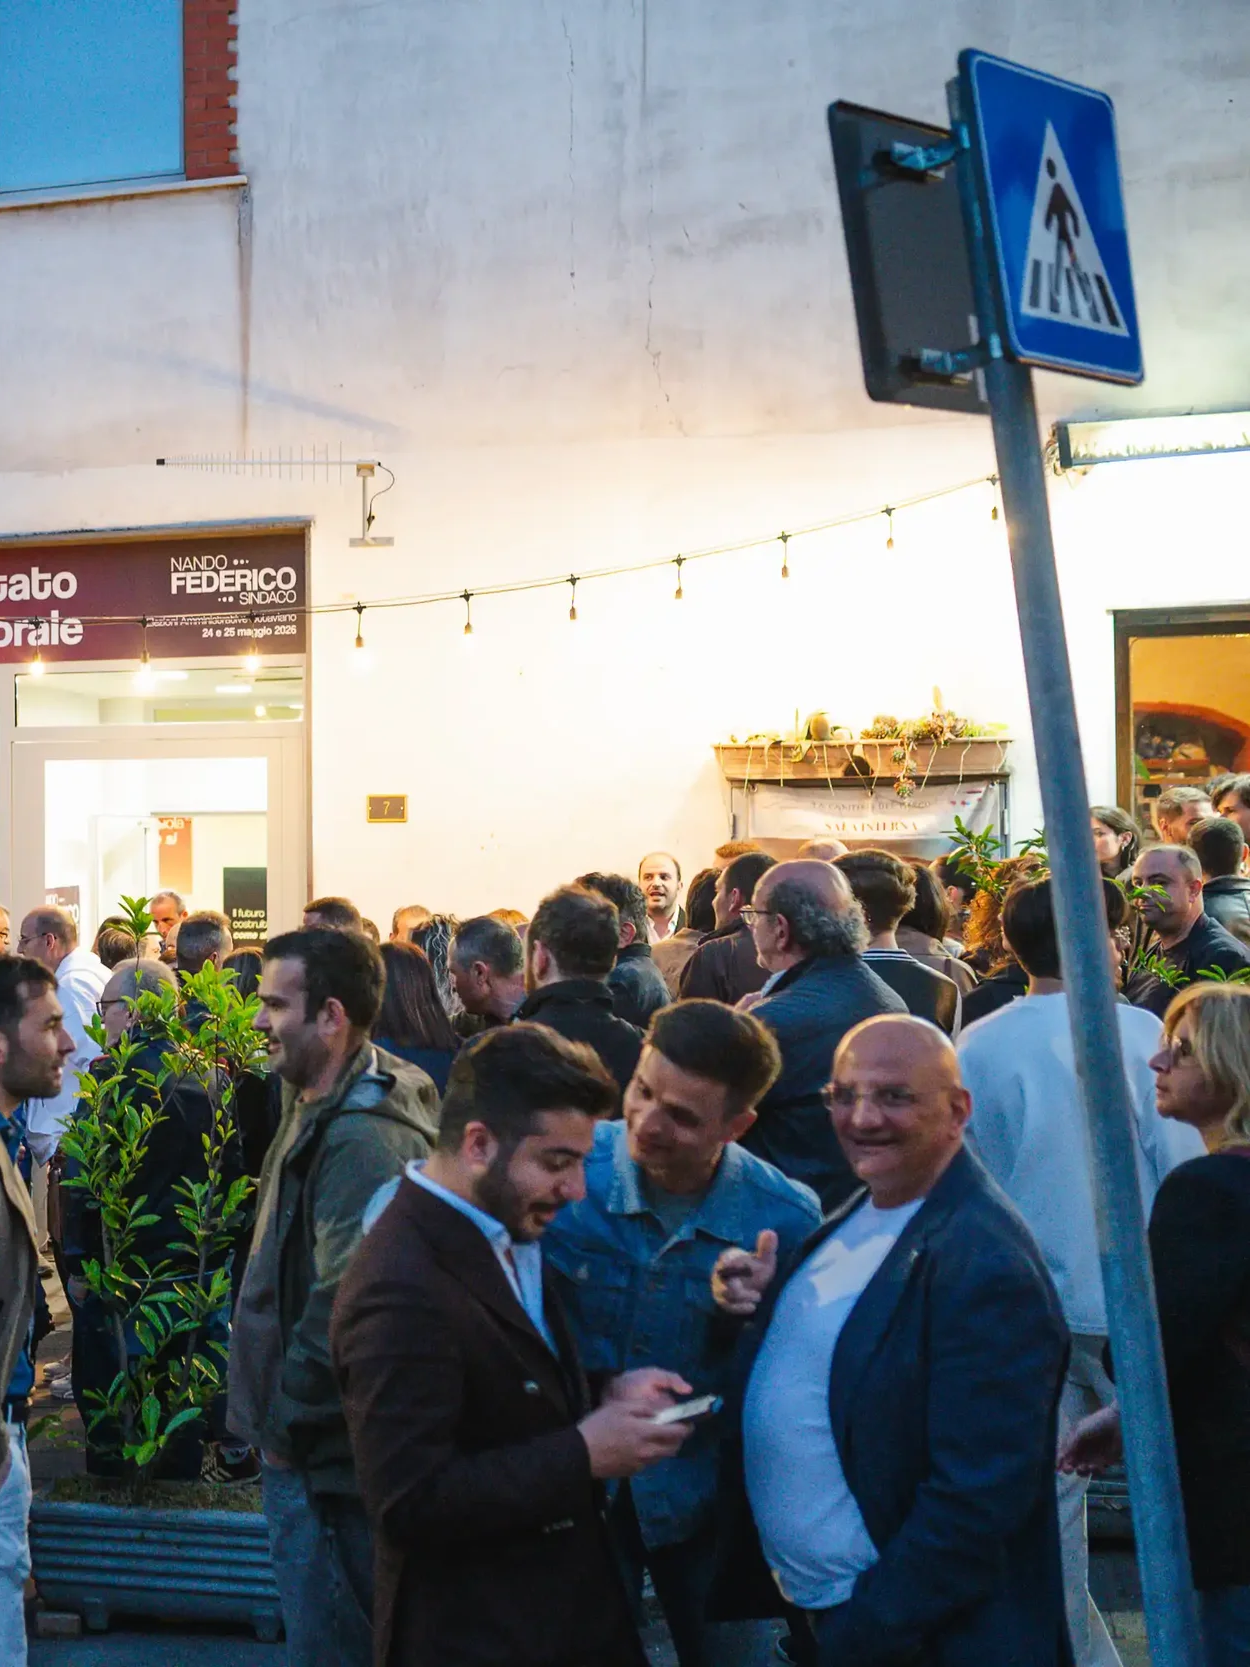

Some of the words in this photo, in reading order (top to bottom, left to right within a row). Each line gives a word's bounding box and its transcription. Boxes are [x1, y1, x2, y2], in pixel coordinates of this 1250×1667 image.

[171, 555, 227, 572] NANDO
[171, 567, 296, 595] FEDERICO
[239, 590, 296, 605] SINDACO
[249, 612, 297, 624] ttaviano
[202, 628, 214, 638] 24
[215, 630, 222, 638] e
[224, 627, 236, 637] 25
[237, 626, 272, 639] maggio
[274, 625, 297, 636] 2026
[383, 800, 390, 815] 7
